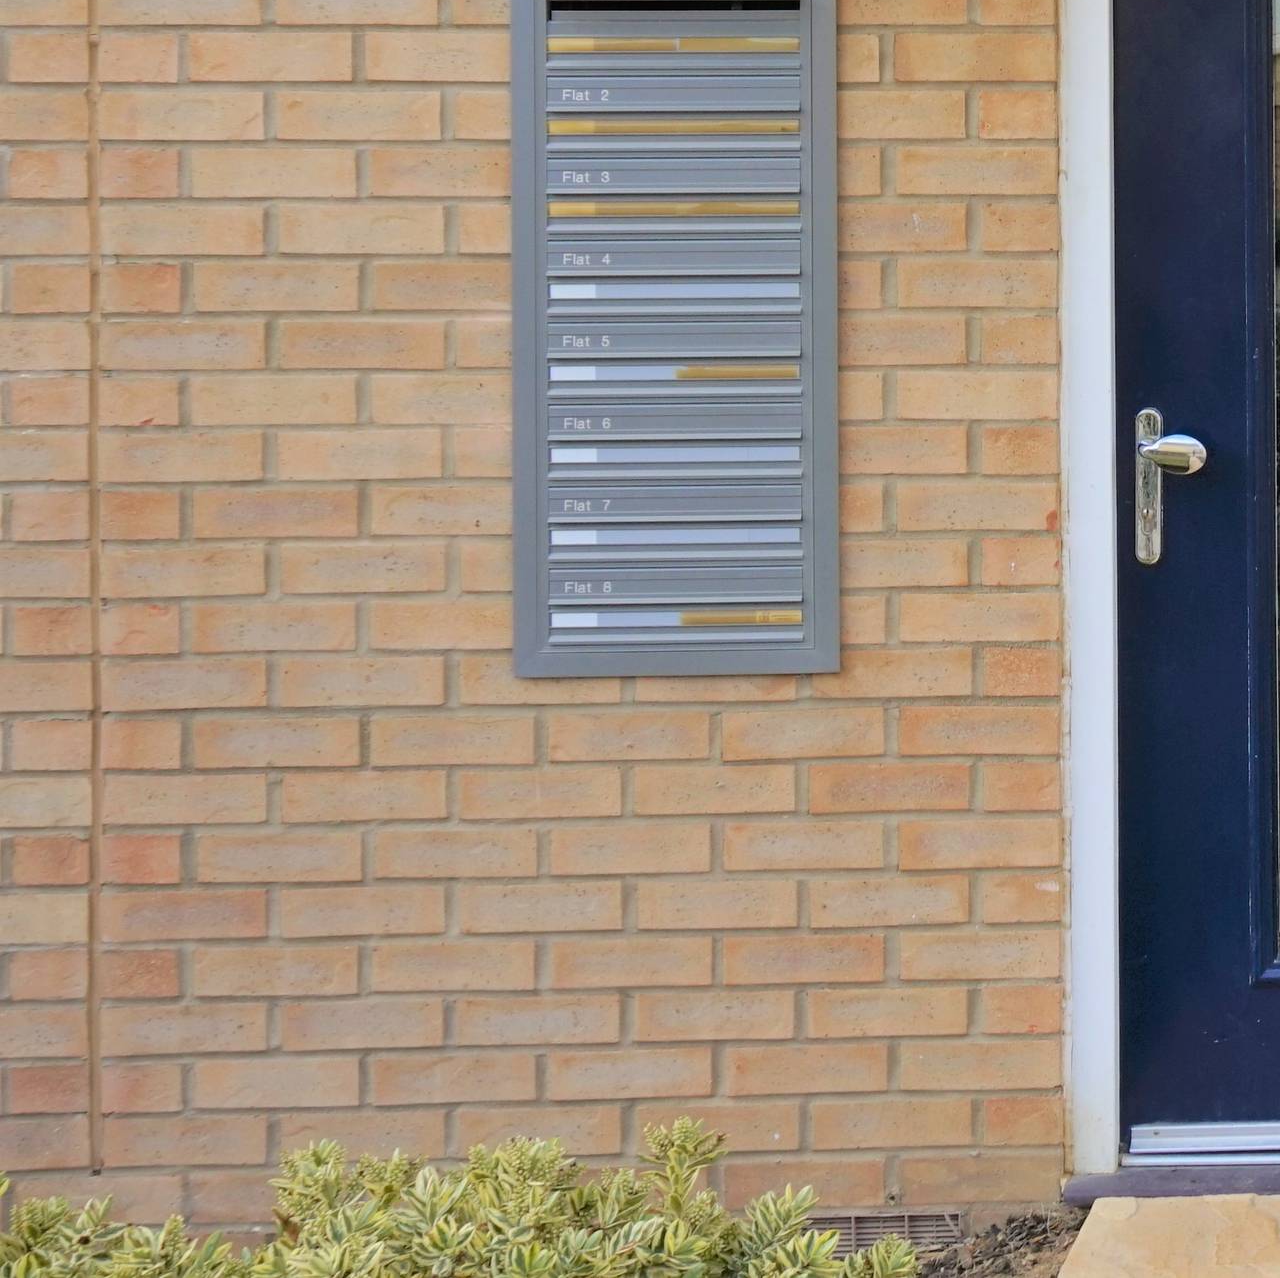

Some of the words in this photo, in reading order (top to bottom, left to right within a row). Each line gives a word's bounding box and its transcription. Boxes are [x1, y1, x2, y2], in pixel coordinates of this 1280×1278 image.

[562, 89, 590, 101] Flat
[600, 89, 609, 101] 2
[562, 171, 590, 183] Flat
[600, 171, 610, 183] 3
[562, 253, 591, 265] Flat
[601, 253, 610, 265] 4
[562, 335, 591, 347] Flat
[601, 335, 610, 347] 5
[563, 417, 592, 430] Flat
[602, 417, 611, 430] 6
[563, 499, 592, 512] Flat
[602, 499, 611, 512] 7
[564, 581, 592, 594] Flat
[602, 581, 612, 594] 8
